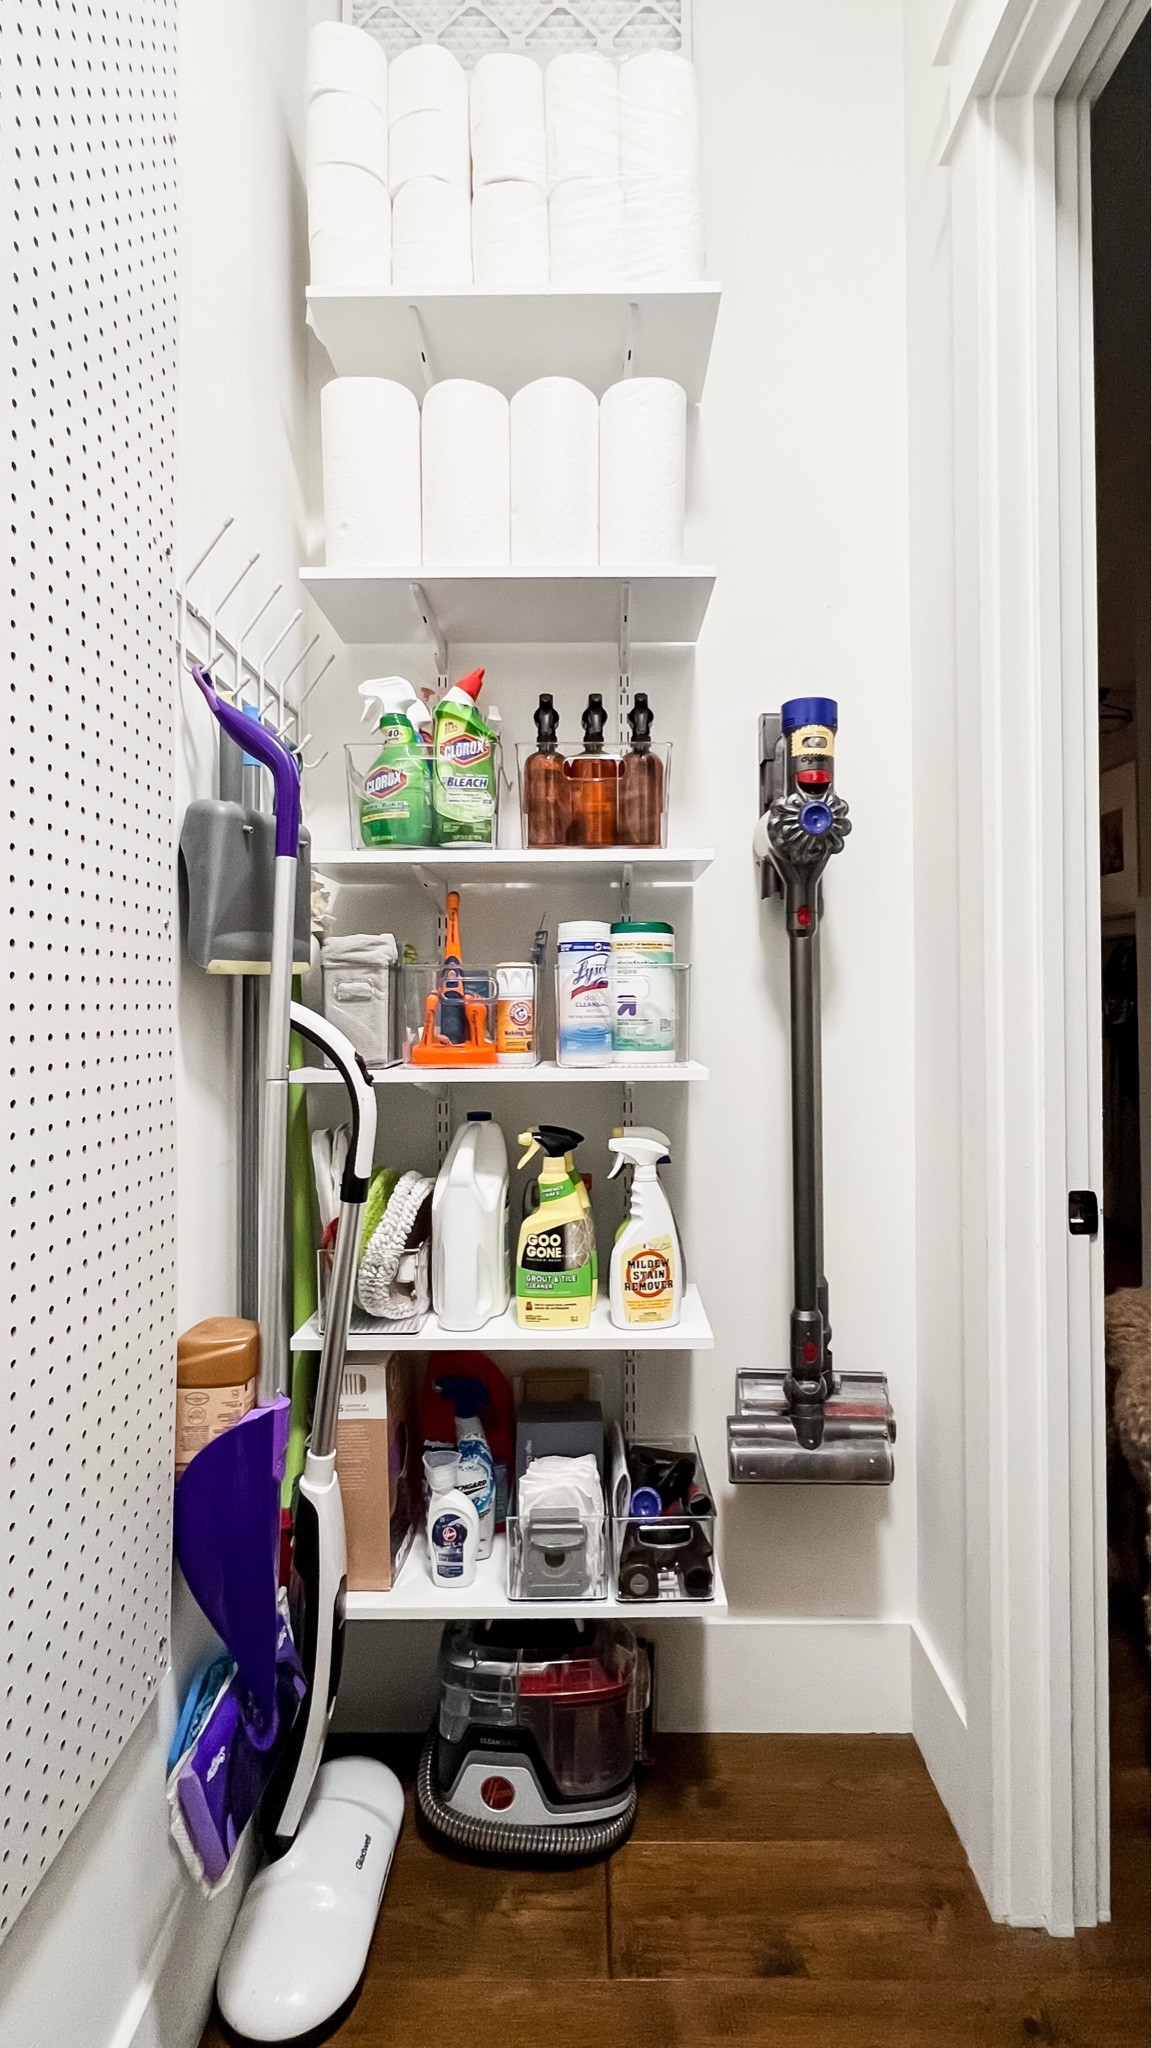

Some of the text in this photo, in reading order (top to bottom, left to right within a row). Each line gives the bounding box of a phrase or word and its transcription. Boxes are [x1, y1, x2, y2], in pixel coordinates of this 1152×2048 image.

[444, 741, 485, 760] CLOROX
[366, 770, 402, 794] CLOROX
[446, 777, 488, 788] BLEACH
[527, 1233, 562, 1247] GOO
[526, 1246, 562, 1258] GONE
[627, 1259, 670, 1269] MILDEW
[526, 1275, 552, 1283] GROUT
[633, 1270, 665, 1281] STAIN
[624, 1279, 674, 1291] REMOVER
